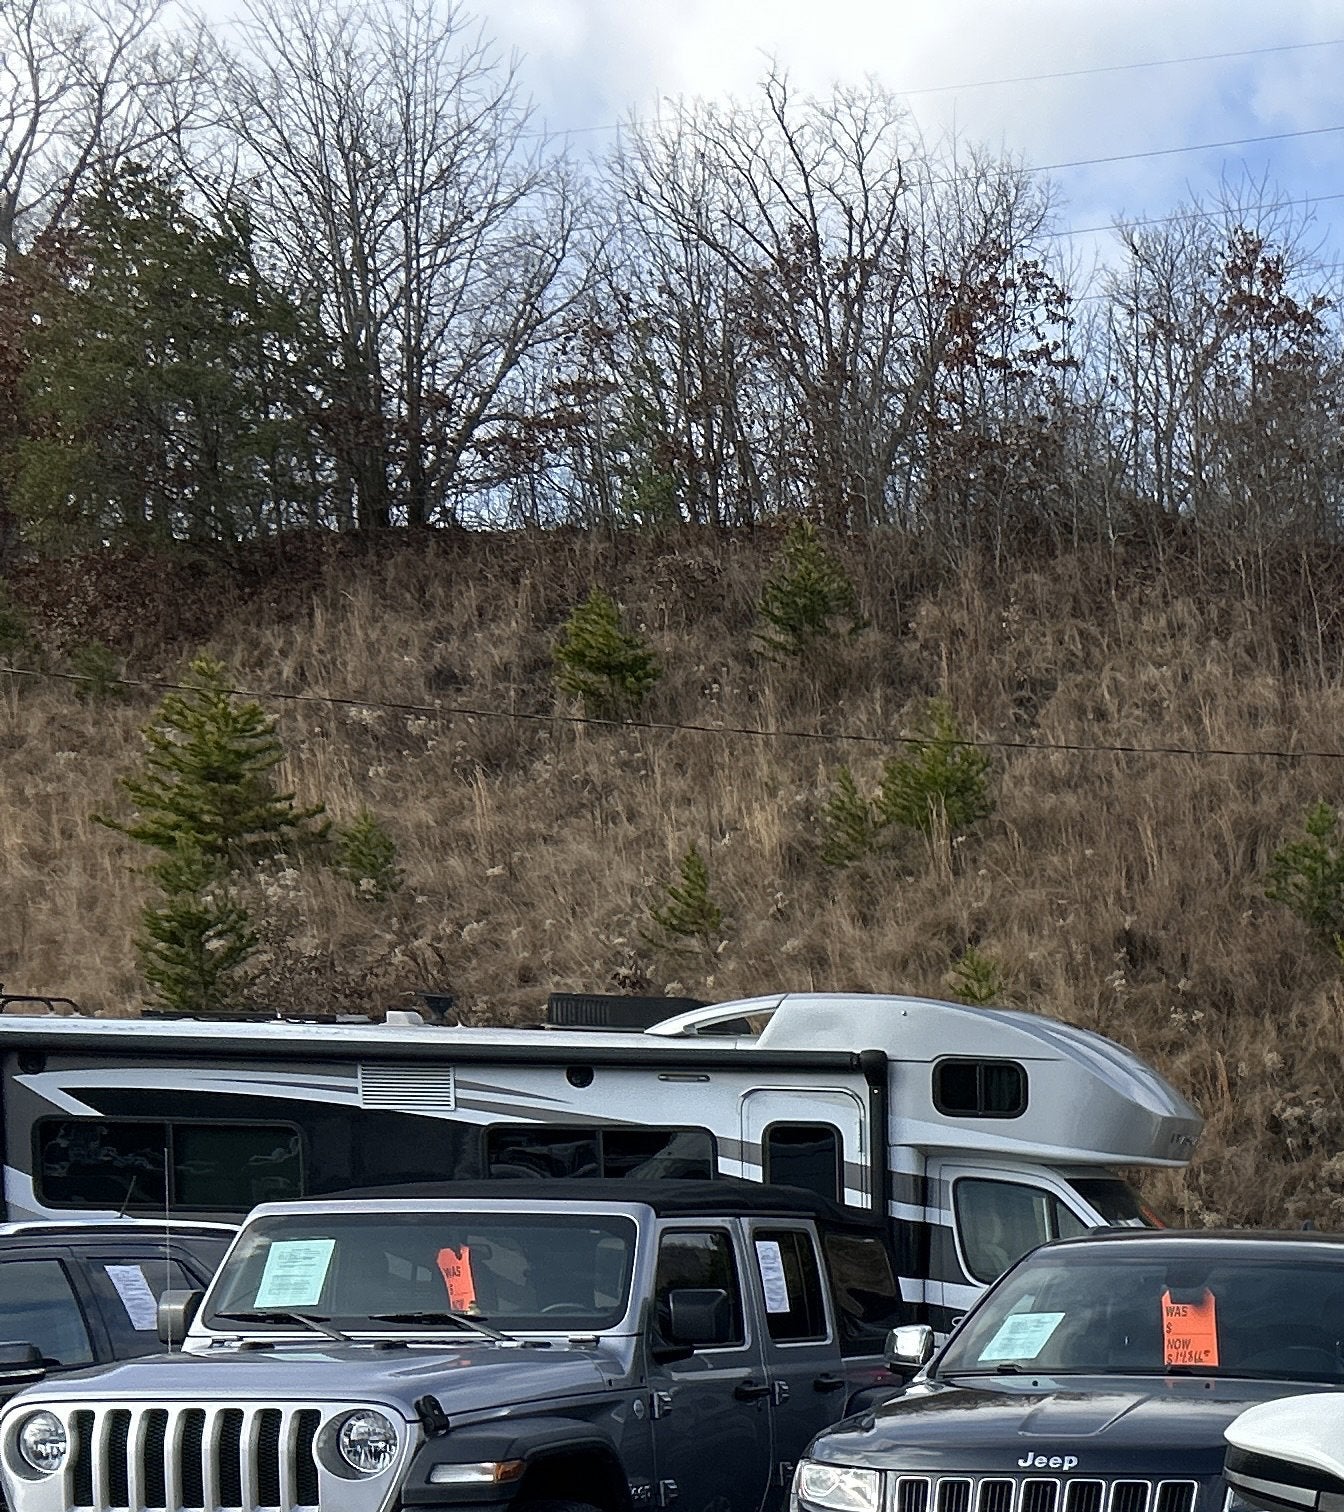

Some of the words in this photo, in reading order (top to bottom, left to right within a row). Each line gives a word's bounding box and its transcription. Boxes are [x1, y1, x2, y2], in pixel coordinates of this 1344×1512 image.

[443, 1266, 461, 1278] WAS
[1166, 1306, 1188, 1317] WAS
[1166, 1339, 1191, 1350] NOW
[1017, 1452, 1078, 1471] Jeep
